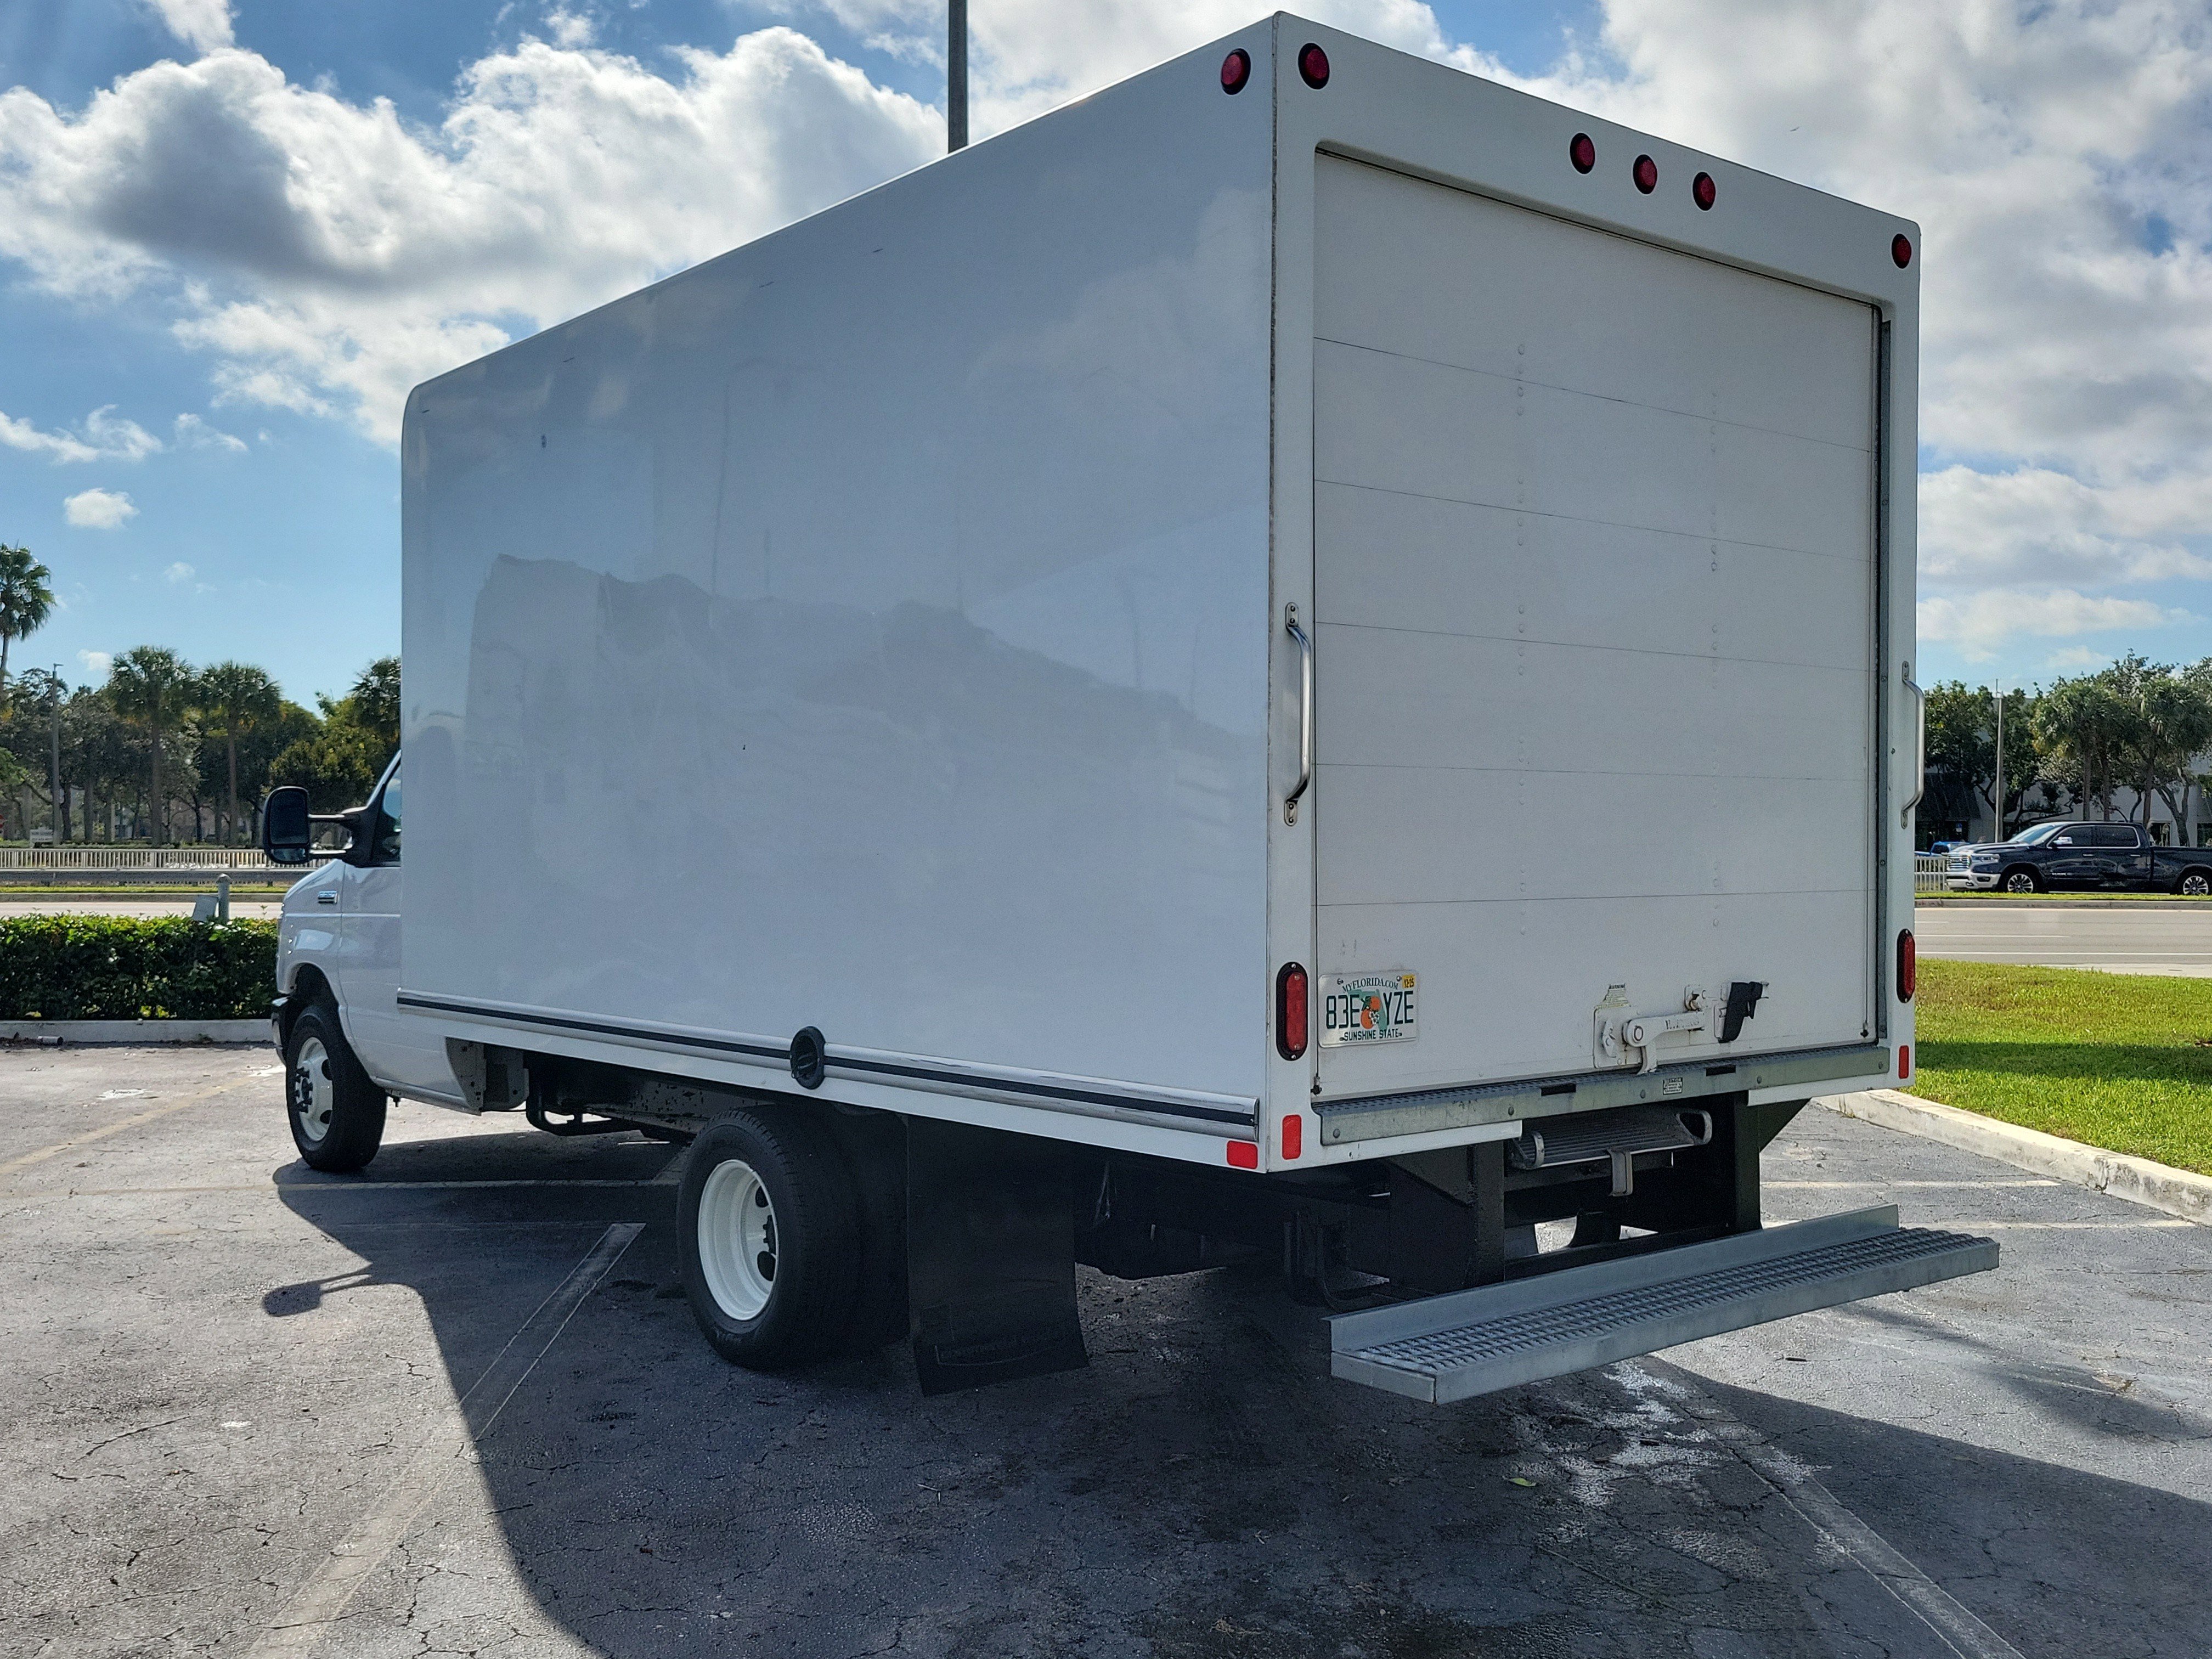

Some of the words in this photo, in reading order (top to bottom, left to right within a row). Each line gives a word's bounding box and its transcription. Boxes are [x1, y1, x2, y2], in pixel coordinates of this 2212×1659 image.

[1342, 978, 1398, 991] MYFLORIDA.COM
[1326, 994, 1360, 1029] 83E
[1383, 990, 1414, 1026] YZE
[1344, 1030, 1376, 1041] SUNSHINE
[1379, 1028, 1399, 1039] STATE
